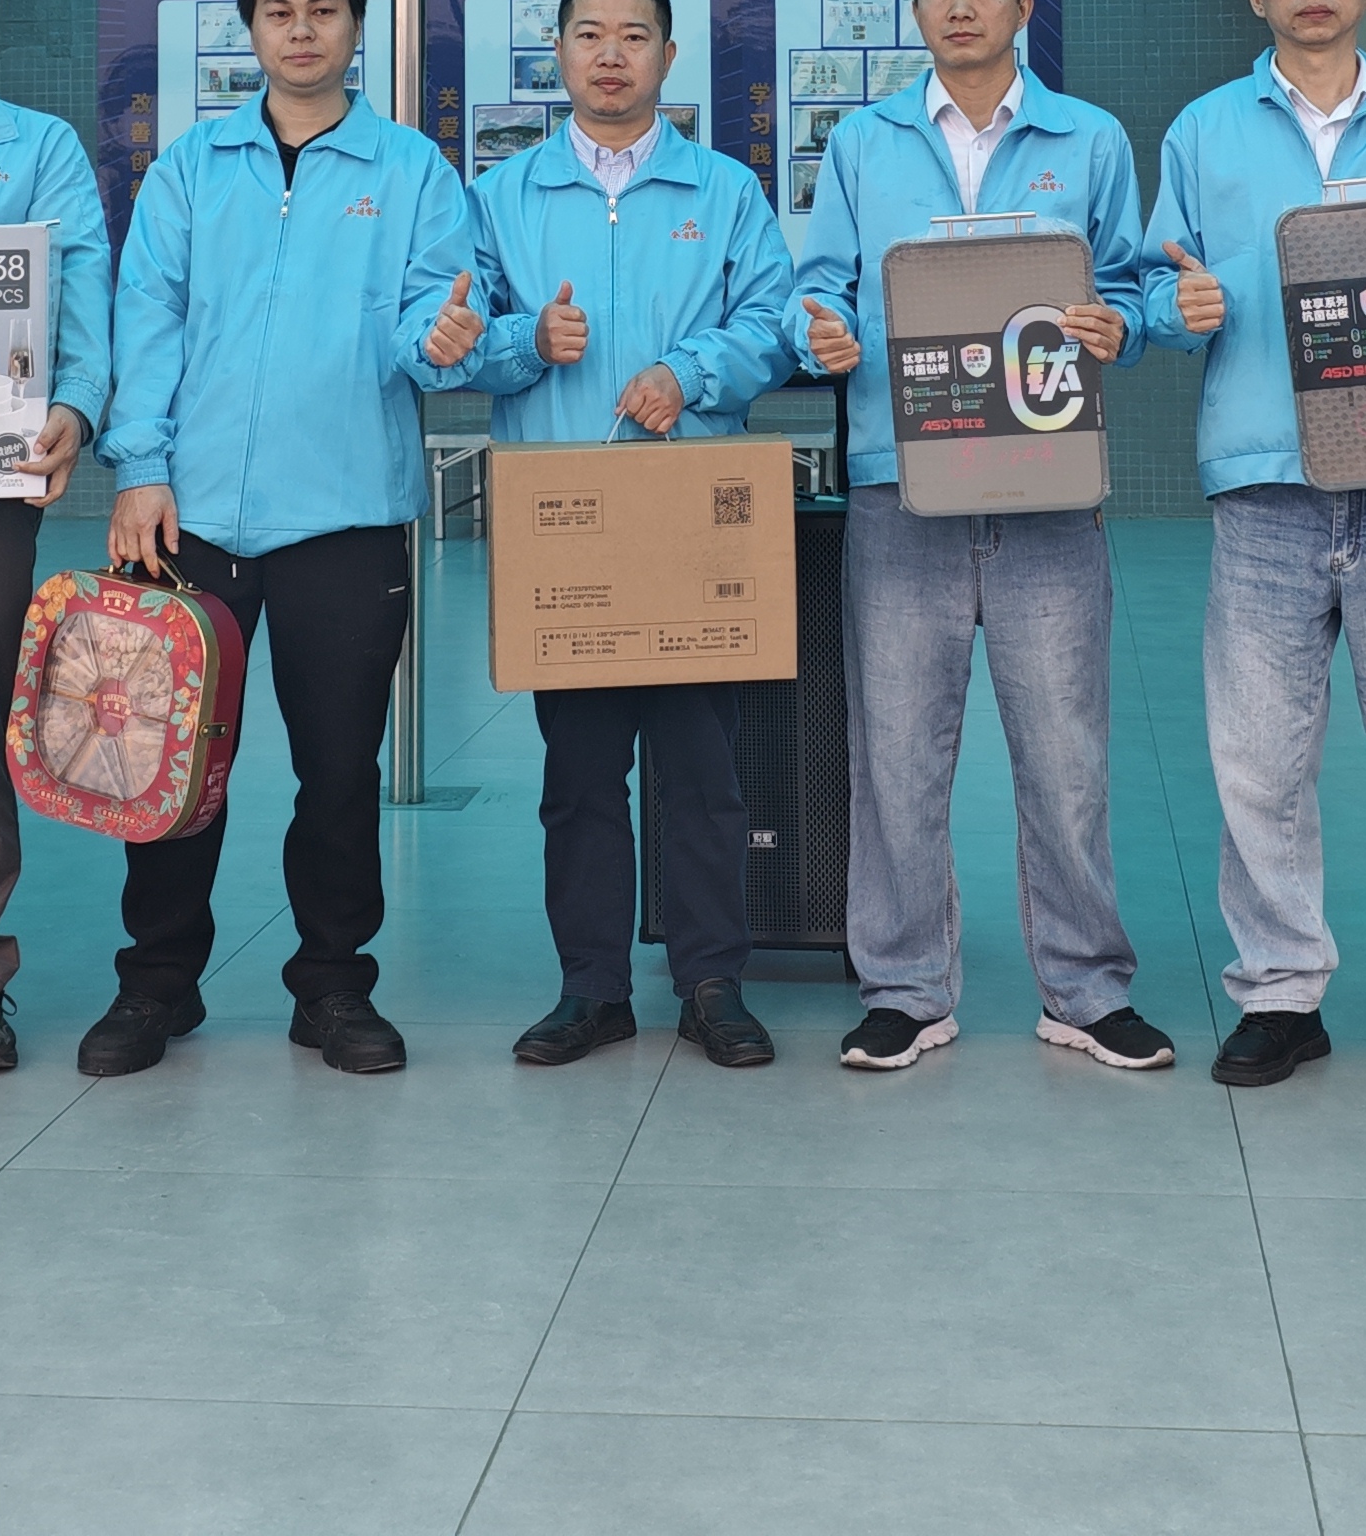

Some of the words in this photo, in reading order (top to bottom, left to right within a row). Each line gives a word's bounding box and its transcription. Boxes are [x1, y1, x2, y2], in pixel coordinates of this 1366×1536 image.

[1026, 343, 1083, 402] 钛
[1321, 365, 1353, 379] ASD
[920, 419, 951, 432] ASD
